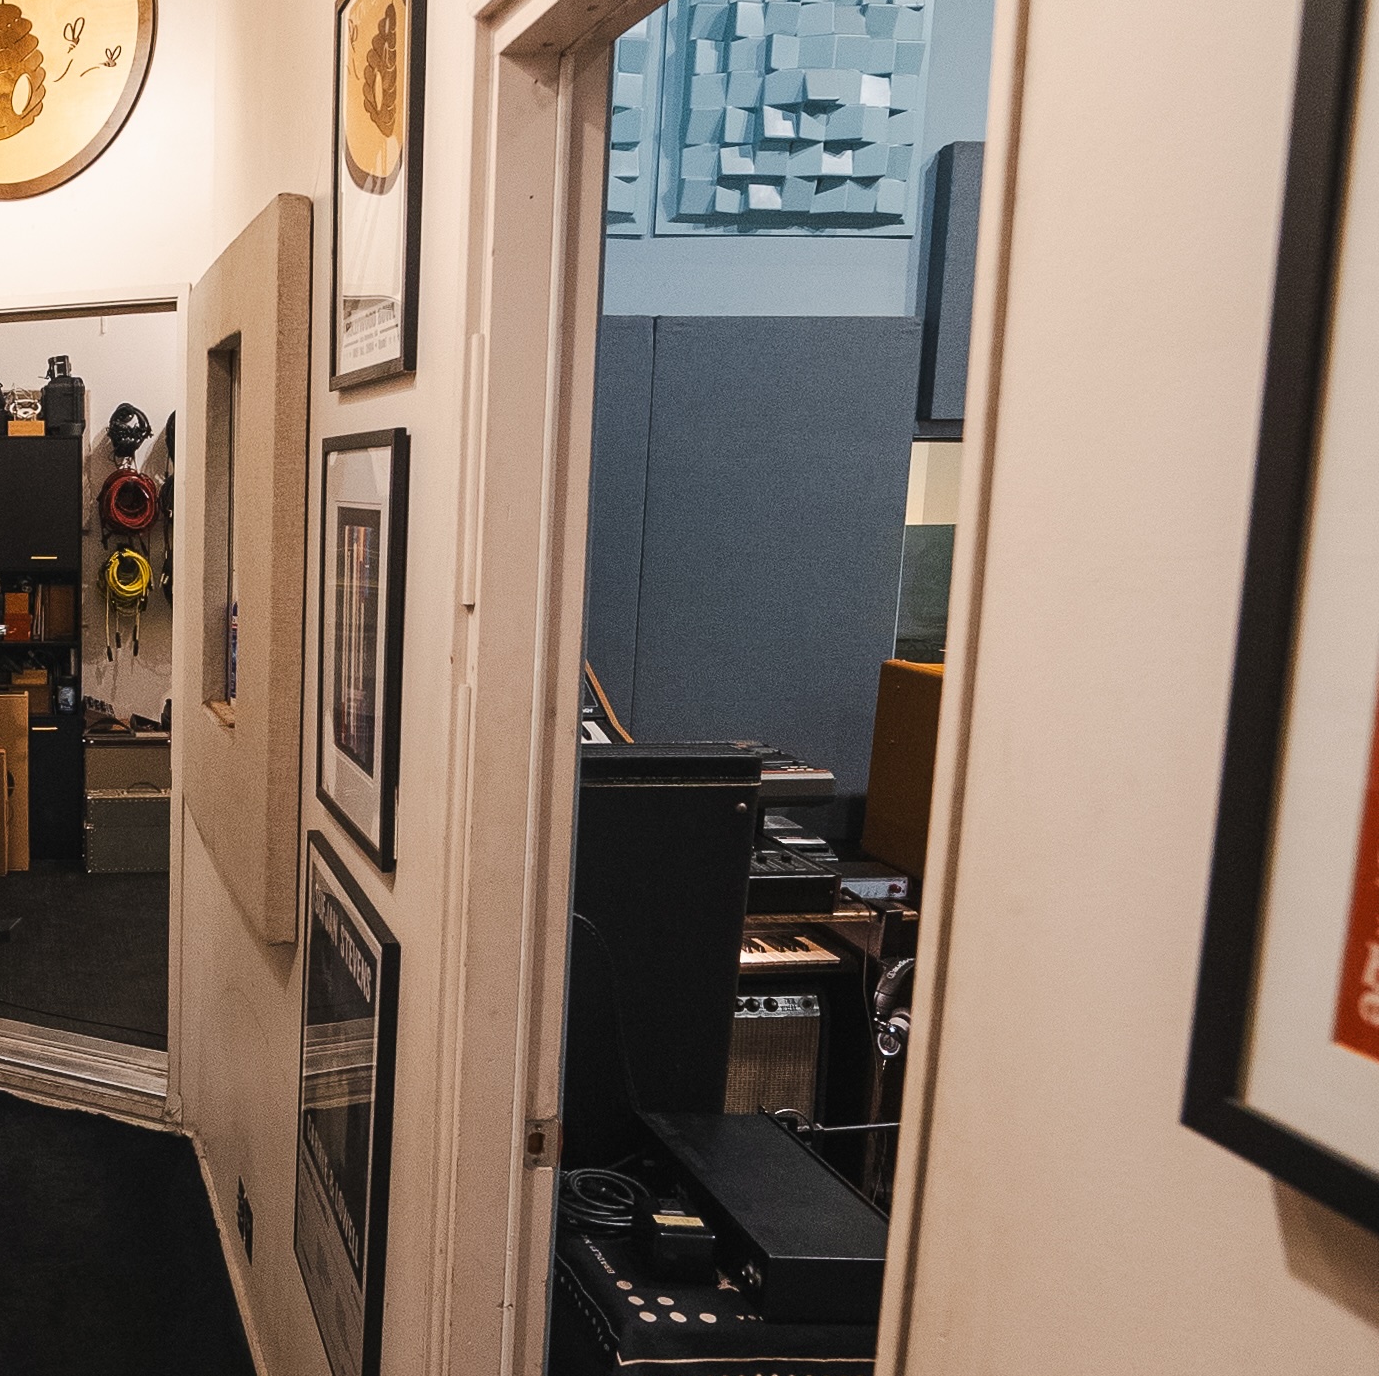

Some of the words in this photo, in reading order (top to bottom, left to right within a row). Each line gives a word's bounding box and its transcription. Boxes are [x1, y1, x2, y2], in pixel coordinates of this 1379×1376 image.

[315, 883, 339, 947] SUFJAN
[340, 922, 372, 1003] STEVENS
[306, 1114, 328, 1185] CARRIE
[328, 1169, 335, 1201] &
[334, 1182, 359, 1268] LOWELL
